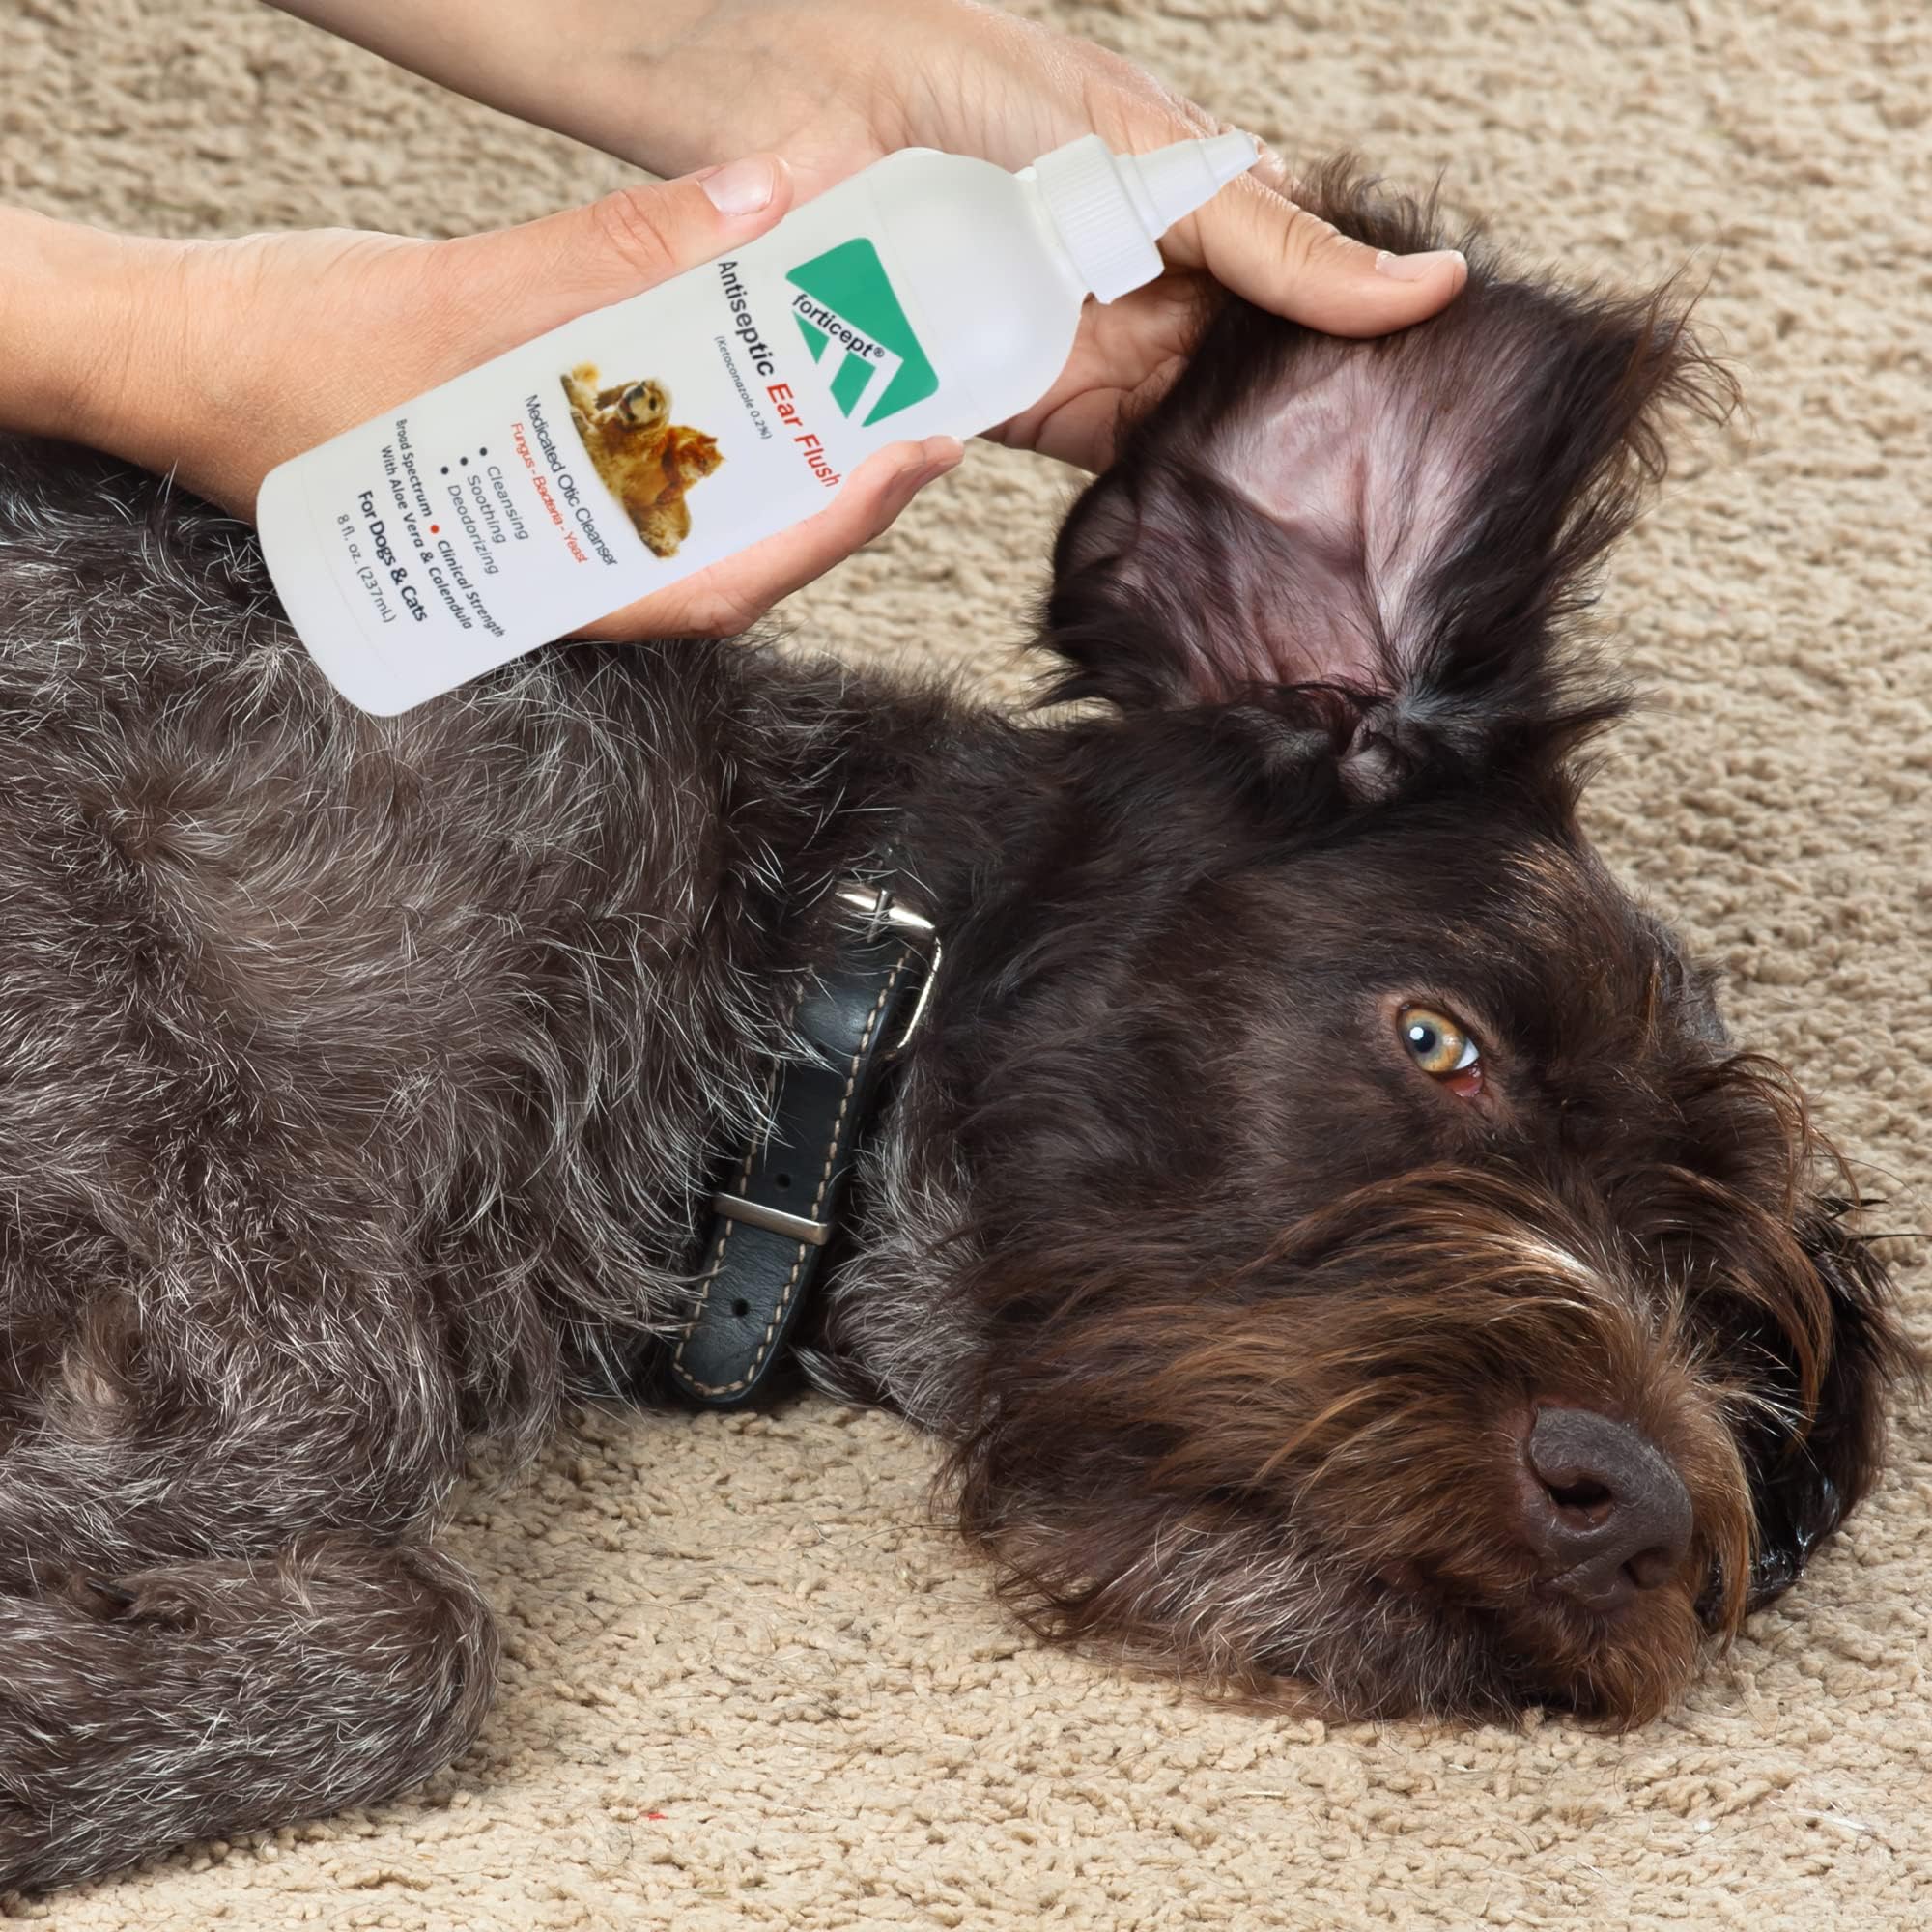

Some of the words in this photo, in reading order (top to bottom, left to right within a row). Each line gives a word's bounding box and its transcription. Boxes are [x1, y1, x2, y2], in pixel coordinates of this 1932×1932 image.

[714, 335, 754, 410] (Ketoconazole
[750, 410, 772, 440] 0.2%)
[718, 261, 774, 377] Antiseptic
[766, 383, 803, 427] Ear
[794, 434, 840, 487] Flush
[382, 445, 397, 476] With
[396, 418, 412, 450] Broad
[389, 477, 408, 510] Aloe
[402, 451, 433, 517] Spectrum
[467, 474, 506, 544] Soothing
[487, 466, 529, 540] Cleansing
[510, 422, 536, 469] Fungus
[533, 475, 564, 526] Bacteria
[563, 532, 588, 563] Yeast
[526, 394, 566, 473] Medicated
[557, 474, 580, 507] Otic
[575, 507, 617, 566] Cleanser
[337, 514, 350, 525] 8
[341, 526, 355, 541] fl.
[403, 512, 424, 548] Vera
[447, 485, 499, 575] Deodorizing
[348, 543, 362, 564] oz.
[357, 490, 377, 520] For
[369, 520, 397, 567] Dogs
[390, 567, 408, 585] &
[401, 585, 428, 622] Cats
[419, 552, 434, 564] &
[437, 539, 472, 590] Clinical
[356, 565, 397, 623] (237mL)
[428, 567, 473, 630] Calendula
[466, 590, 505, 638] Strength
